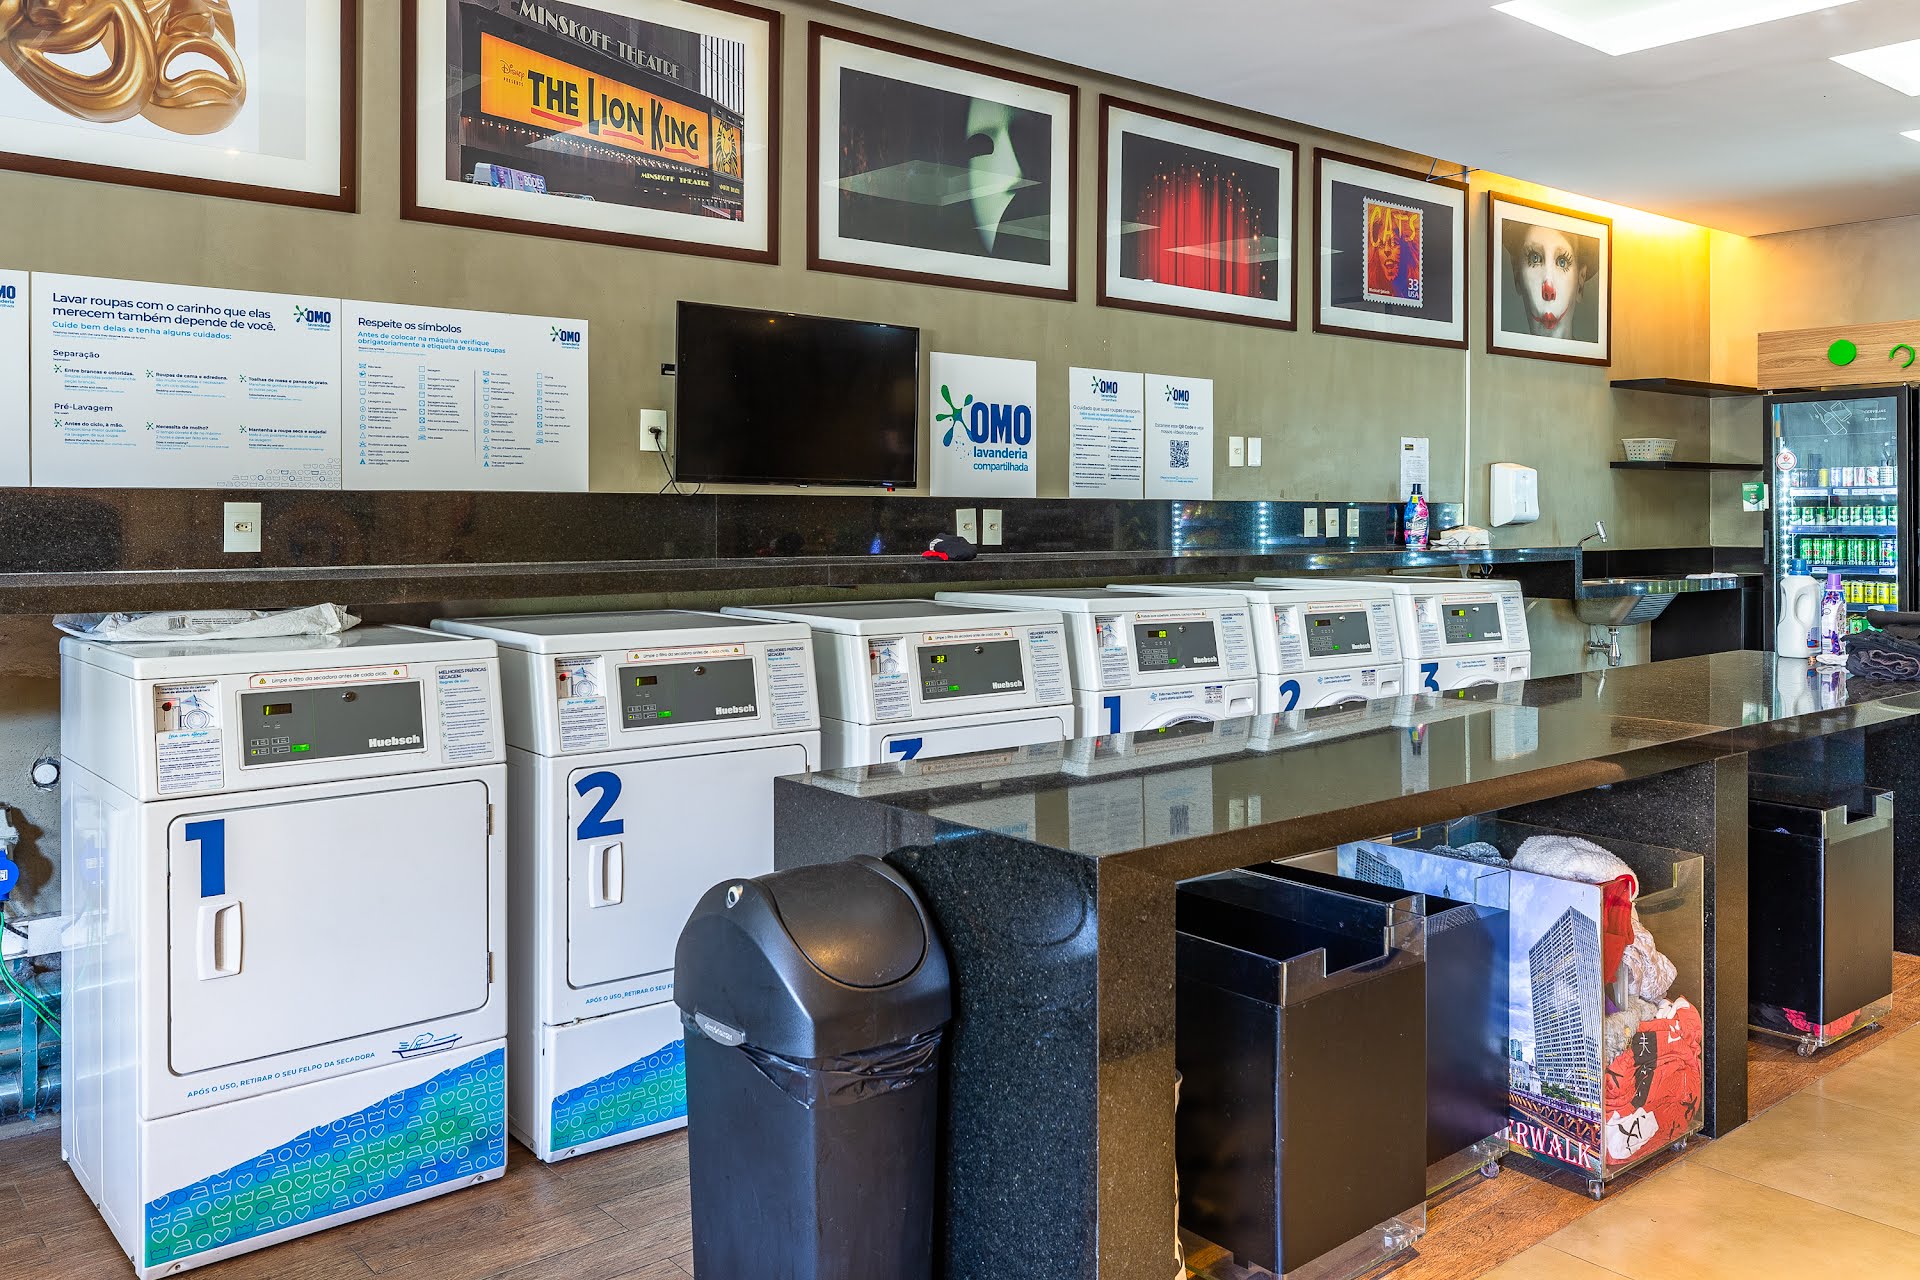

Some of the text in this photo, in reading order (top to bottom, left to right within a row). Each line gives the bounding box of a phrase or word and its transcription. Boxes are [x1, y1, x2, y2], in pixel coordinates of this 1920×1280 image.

[519, 0, 681, 81] MINSKOFF THEATRE
[528, 70, 579, 118] THE
[640, 172, 710, 188] MINSKOFF THEATRE
[1370, 206, 1418, 247] CATS
[1408, 278, 1419, 290] 33
[1407, 290, 1419, 299] USA
[52, 292, 271, 319] Lavar roupas com o carinho que elas
[52, 307, 276, 331] merecem também depende de você.
[306, 310, 331, 324] OMO
[358, 317, 462, 333] Respeite os símbolos
[52, 321, 79, 329] Cuide
[81, 321, 101, 331] bem
[103, 324, 126, 333] delas
[136, 327, 161, 335] tenha
[163, 328, 191, 339] alguns
[193, 331, 232, 340] cuidados:
[560, 330, 580, 343] OMO
[358, 338, 420, 348] obrigatoriamente
[427, 343, 456, 351] etiqueta
[483, 346, 506, 354] roupas
[391, 333, 417, 341] colocar
[428, 335, 458, 346] máquina
[460, 338, 489, 347] verifique
[53, 349, 100, 360] Separação
[1100, 380, 1118, 394] OMO
[1173, 389, 1189, 402] OMO
[54, 402, 113, 412] Pré-Lavagem
[970, 401, 1032, 446] OMO
[973, 445, 1028, 459] lavanderia
[973, 461, 1029, 472] compartilhada
[936, 655, 945, 663] 32
[992, 680, 1023, 690] Huebsch
[1279, 679, 1301, 712] 2
[715, 703, 755, 716] Huebsch
[1103, 695, 1121, 734] 1
[369, 734, 421, 748] Huebsch
[574, 770, 624, 841] 2
[184, 818, 226, 899] 1
[585, 996, 602, 1005] APÓS
[609, 992, 624, 1000] USO,
[624, 989, 649, 997] RETIRAR
[655, 984, 667, 992] SEU
[187, 1087, 210, 1098] APÓS
[211, 1085, 218, 1093] O
[219, 1081, 239, 1092] USO,
[240, 1074, 273, 1087] RETIRAR
[281, 1068, 297, 1078] SEU
[298, 1063, 323, 1074] FELPO
[324, 1061, 335, 1069] DA
[336, 1052, 376, 1067] SECADORA
